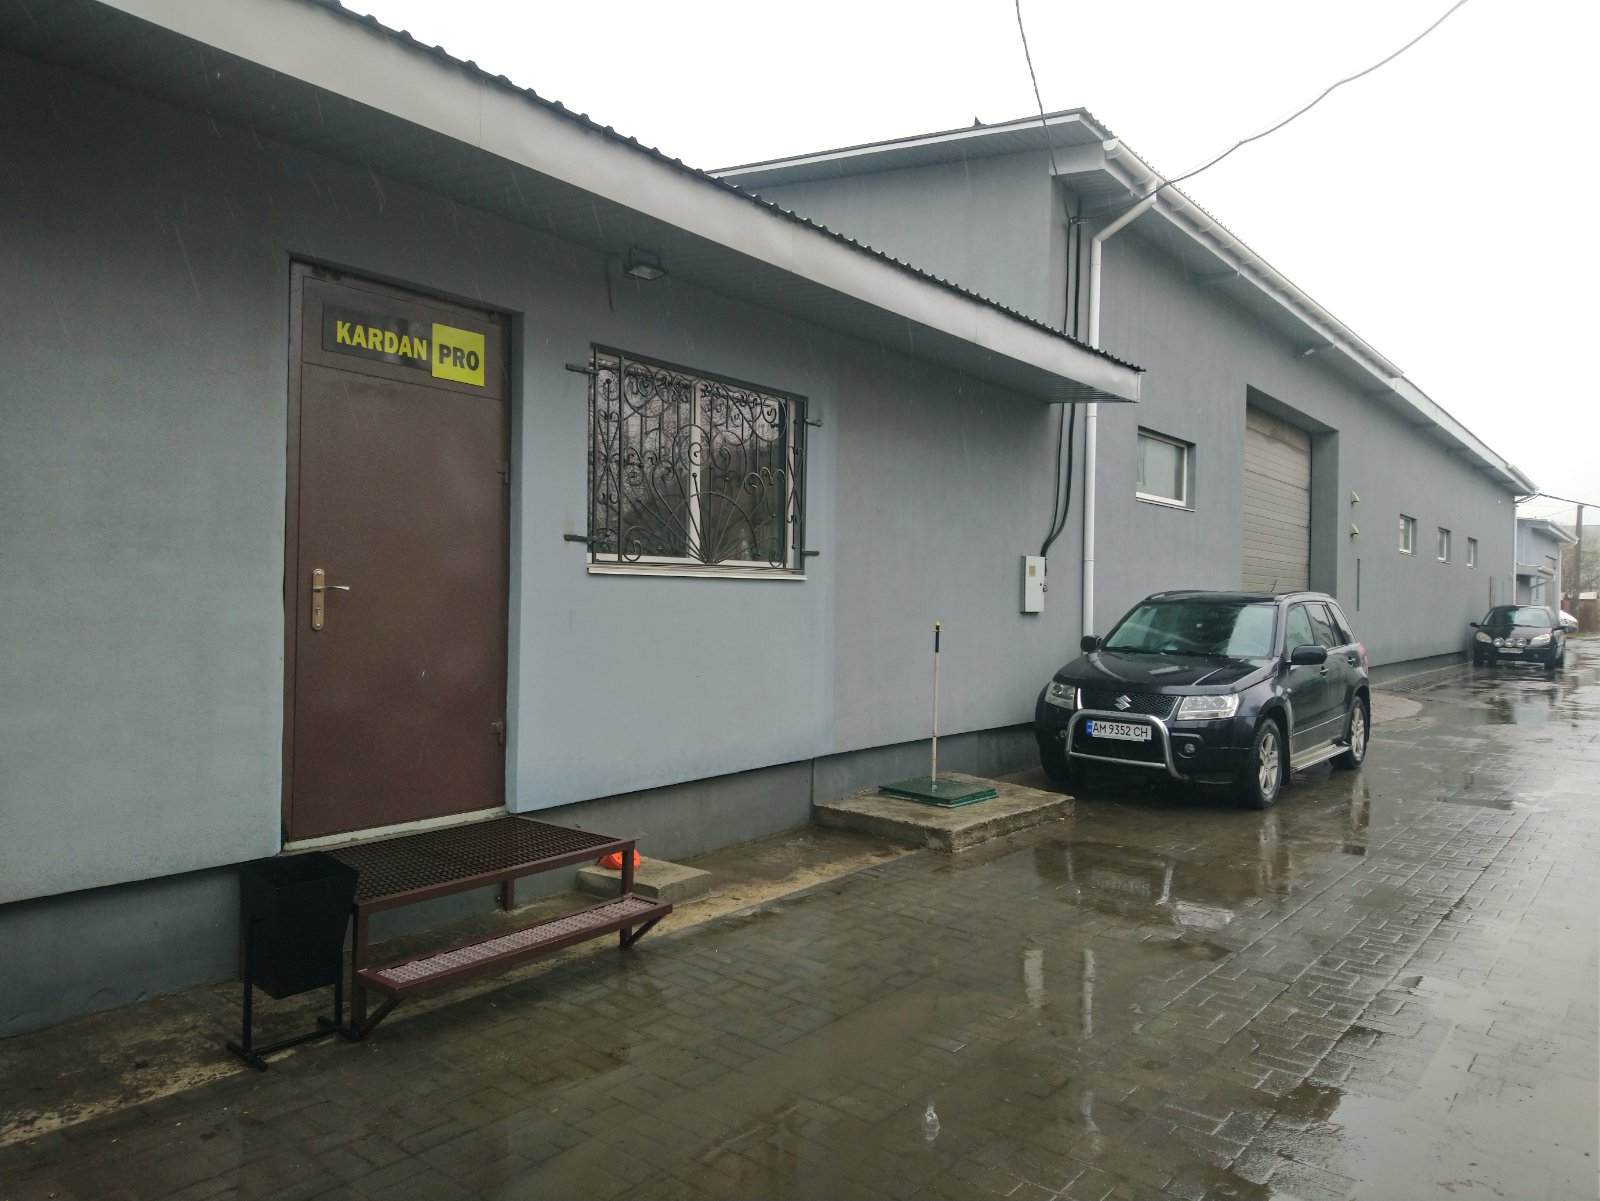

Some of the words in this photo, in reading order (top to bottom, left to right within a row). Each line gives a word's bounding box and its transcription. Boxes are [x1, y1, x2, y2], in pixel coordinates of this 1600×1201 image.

[336, 320, 427, 361] KARDAN
[438, 343, 480, 371] PRO
[1093, 723, 1107, 734] AM
[1109, 724, 1131, 736] 9352
[1133, 726, 1148, 738] CH
